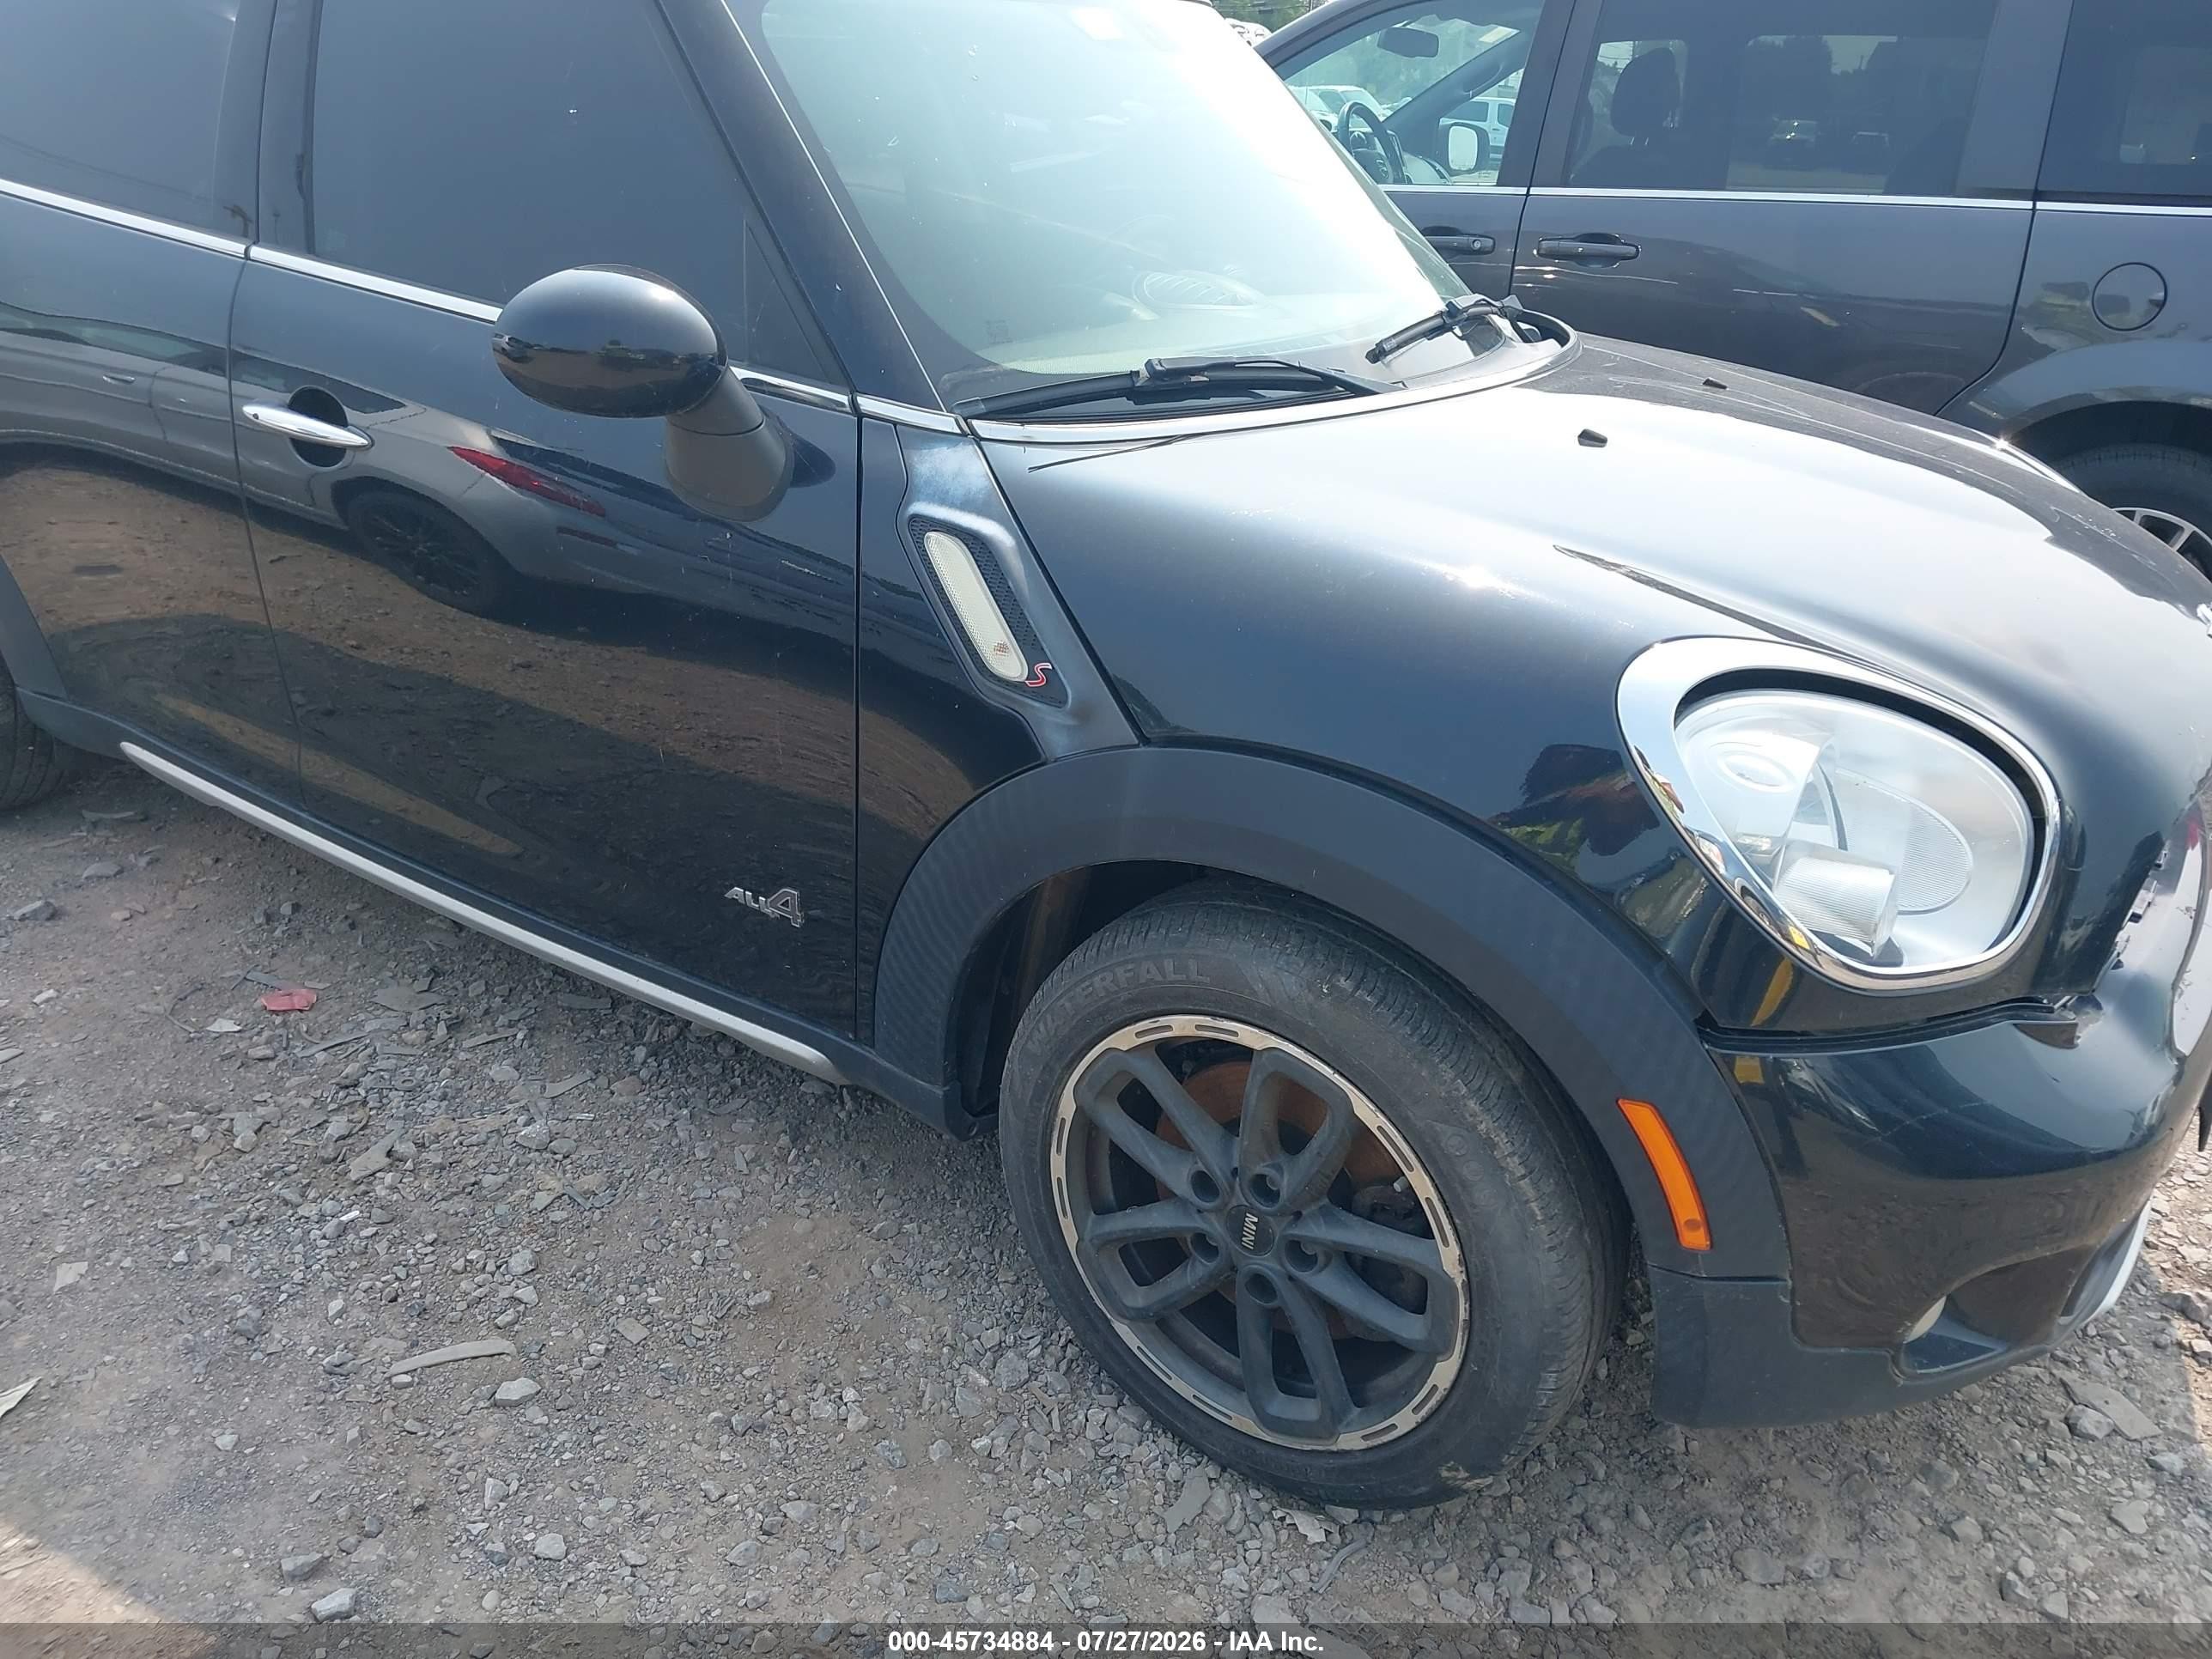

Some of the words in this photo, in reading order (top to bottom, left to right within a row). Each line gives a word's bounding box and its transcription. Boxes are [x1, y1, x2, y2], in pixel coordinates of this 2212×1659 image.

[1024, 662, 1053, 687] S
[724, 886, 801, 928] ALL4
[1241, 1212, 1260, 1250] MINI
